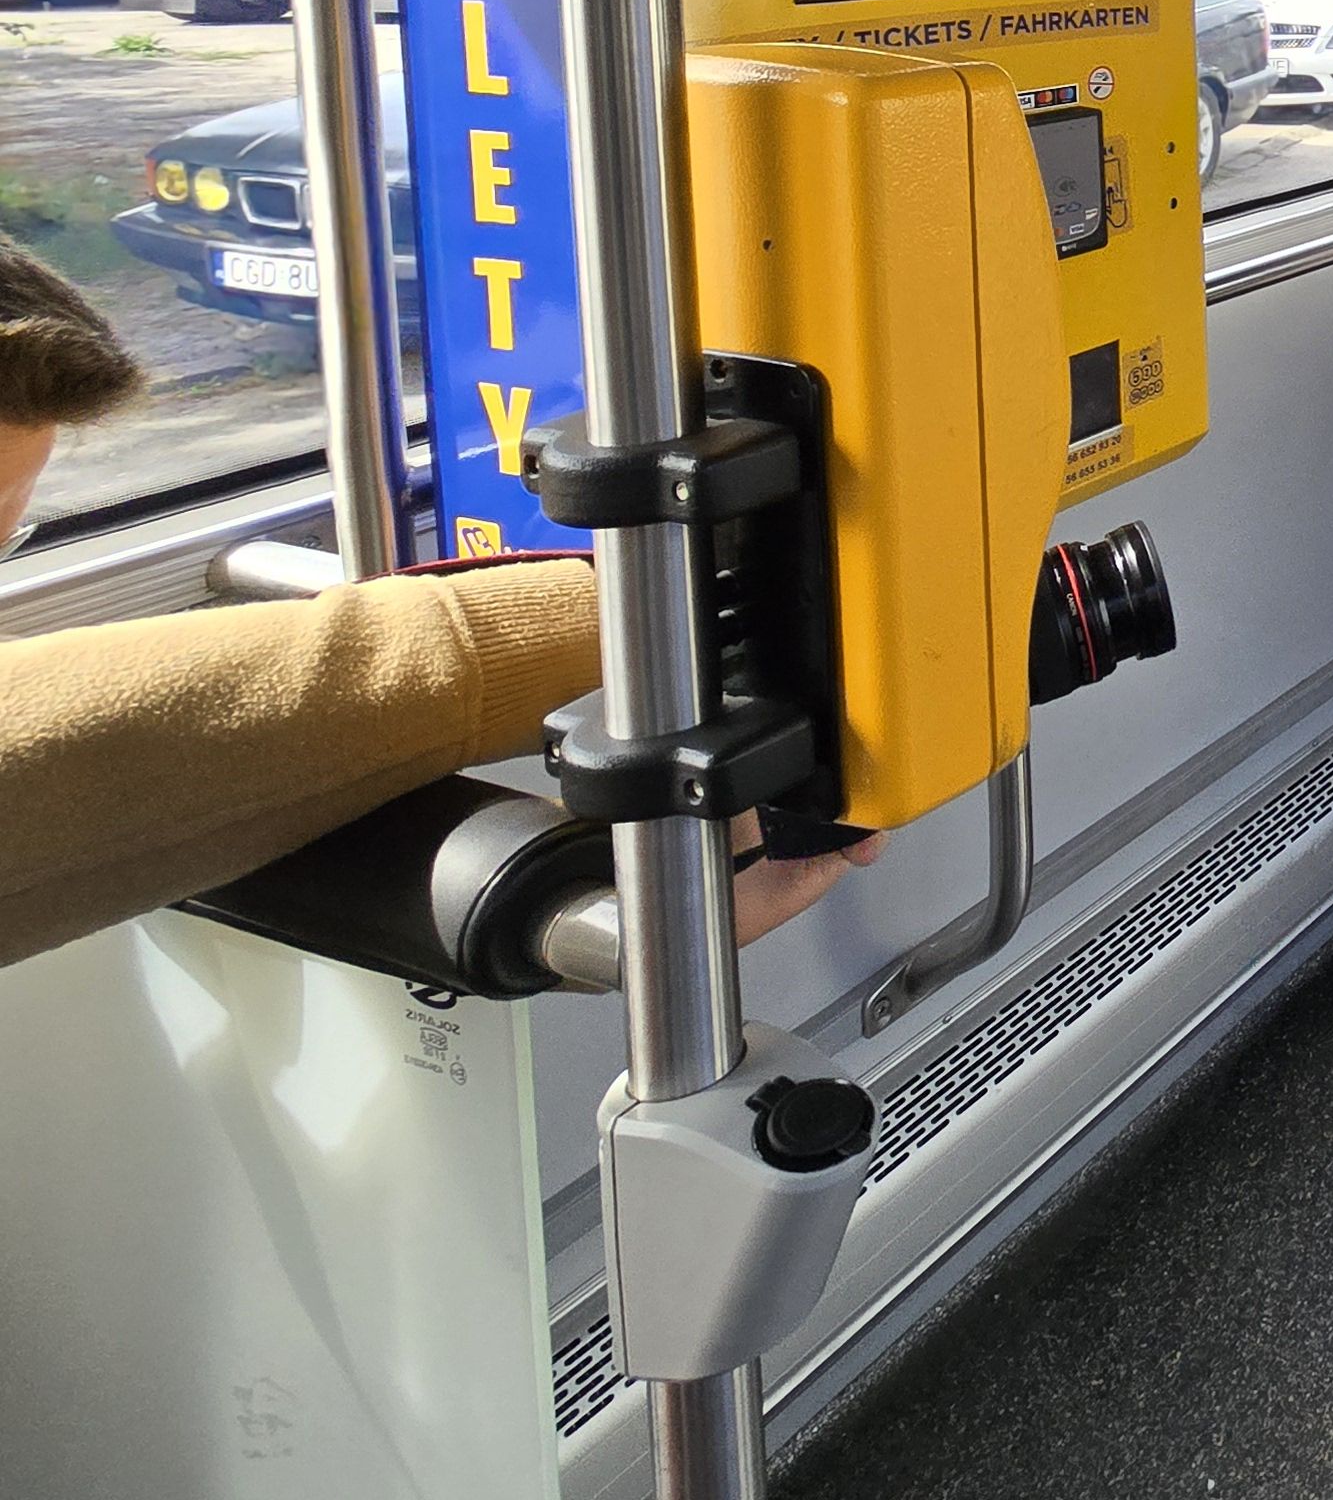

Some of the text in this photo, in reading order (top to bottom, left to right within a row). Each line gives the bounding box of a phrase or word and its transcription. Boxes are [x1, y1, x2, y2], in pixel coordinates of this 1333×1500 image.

[854, 20, 972, 47] TICKETS
[1000, 5, 1150, 37] FAHRKARTEN
[230, 257, 319, 293] CGD 8U
